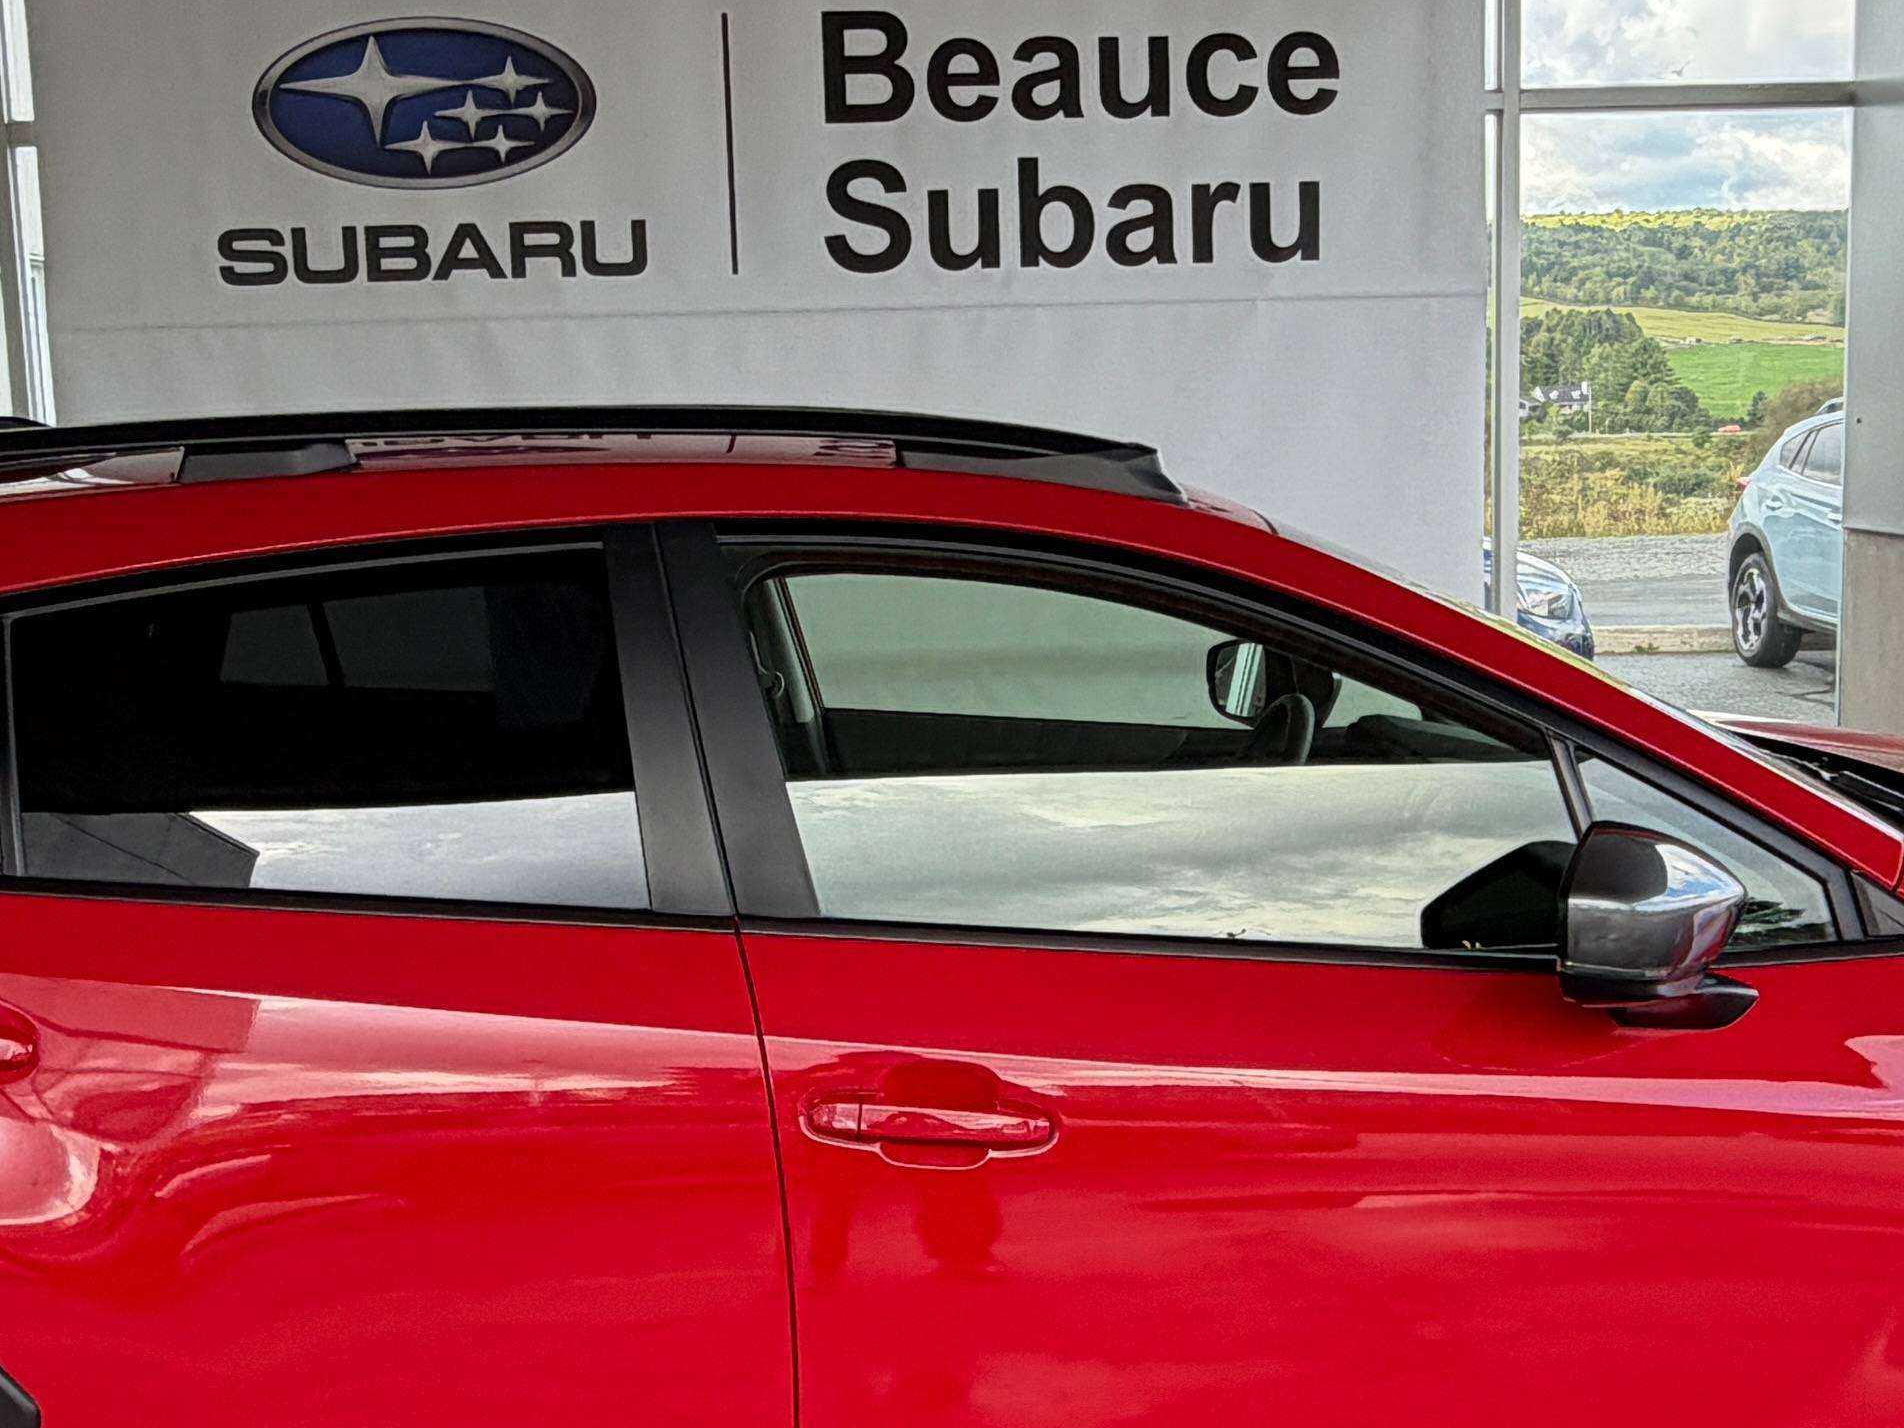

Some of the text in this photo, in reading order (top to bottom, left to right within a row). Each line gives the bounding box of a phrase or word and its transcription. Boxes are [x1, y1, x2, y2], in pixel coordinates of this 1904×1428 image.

[821, 10, 1340, 124] Beauce
[216, 218, 648, 287] SUBARU
[823, 156, 1321, 274] Subaru
